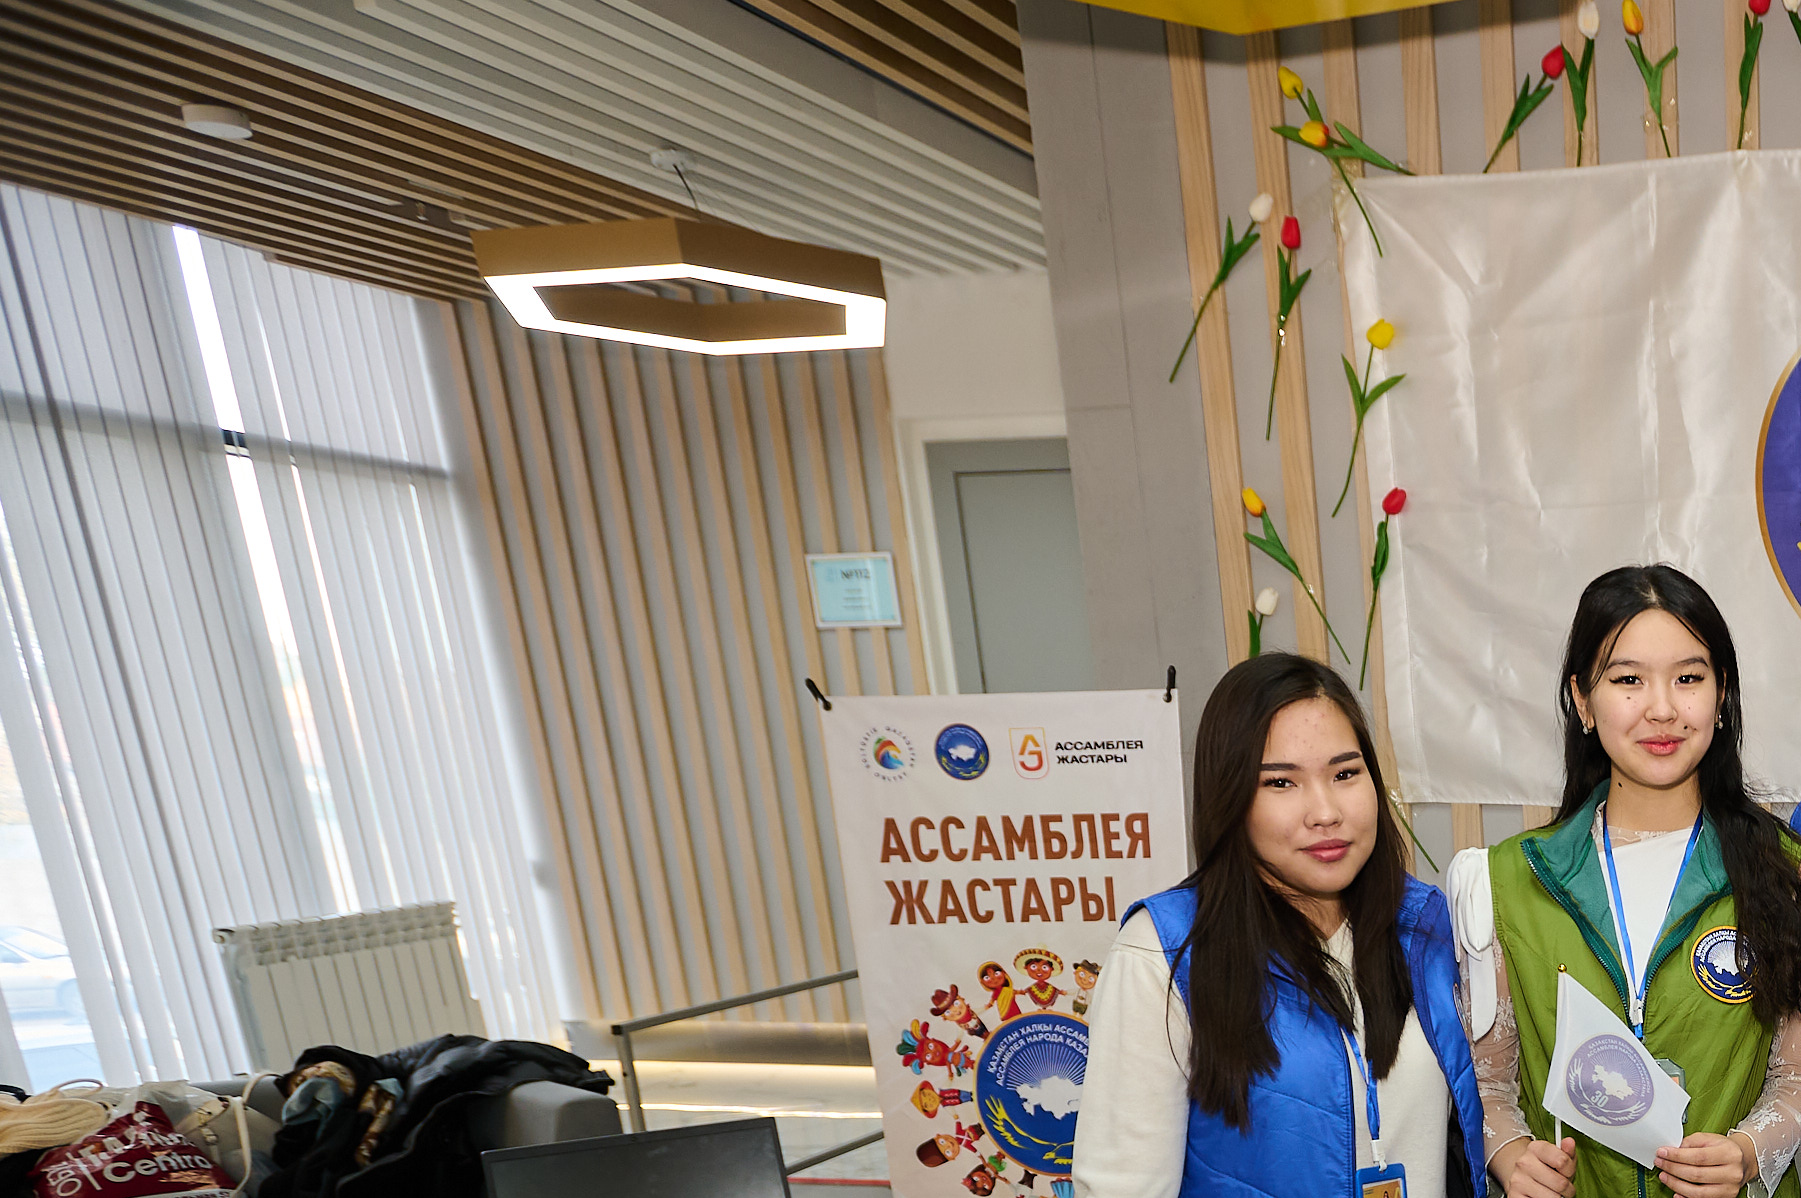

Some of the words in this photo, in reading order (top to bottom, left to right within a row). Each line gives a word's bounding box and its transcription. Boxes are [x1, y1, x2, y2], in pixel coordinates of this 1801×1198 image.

[1054, 739, 1144, 752] АССАМБЛЕЯ
[1056, 752, 1128, 765] ЖАСТАРЫ
[880, 812, 1152, 863] АССАМБЛЕЯ
[885, 876, 1117, 926] ЖАСТАРЫ
[1025, 1033, 1064, 1044] НАРОДА
[1591, 1089, 1609, 1108] 30
[103, 1151, 213, 1183] Centro
